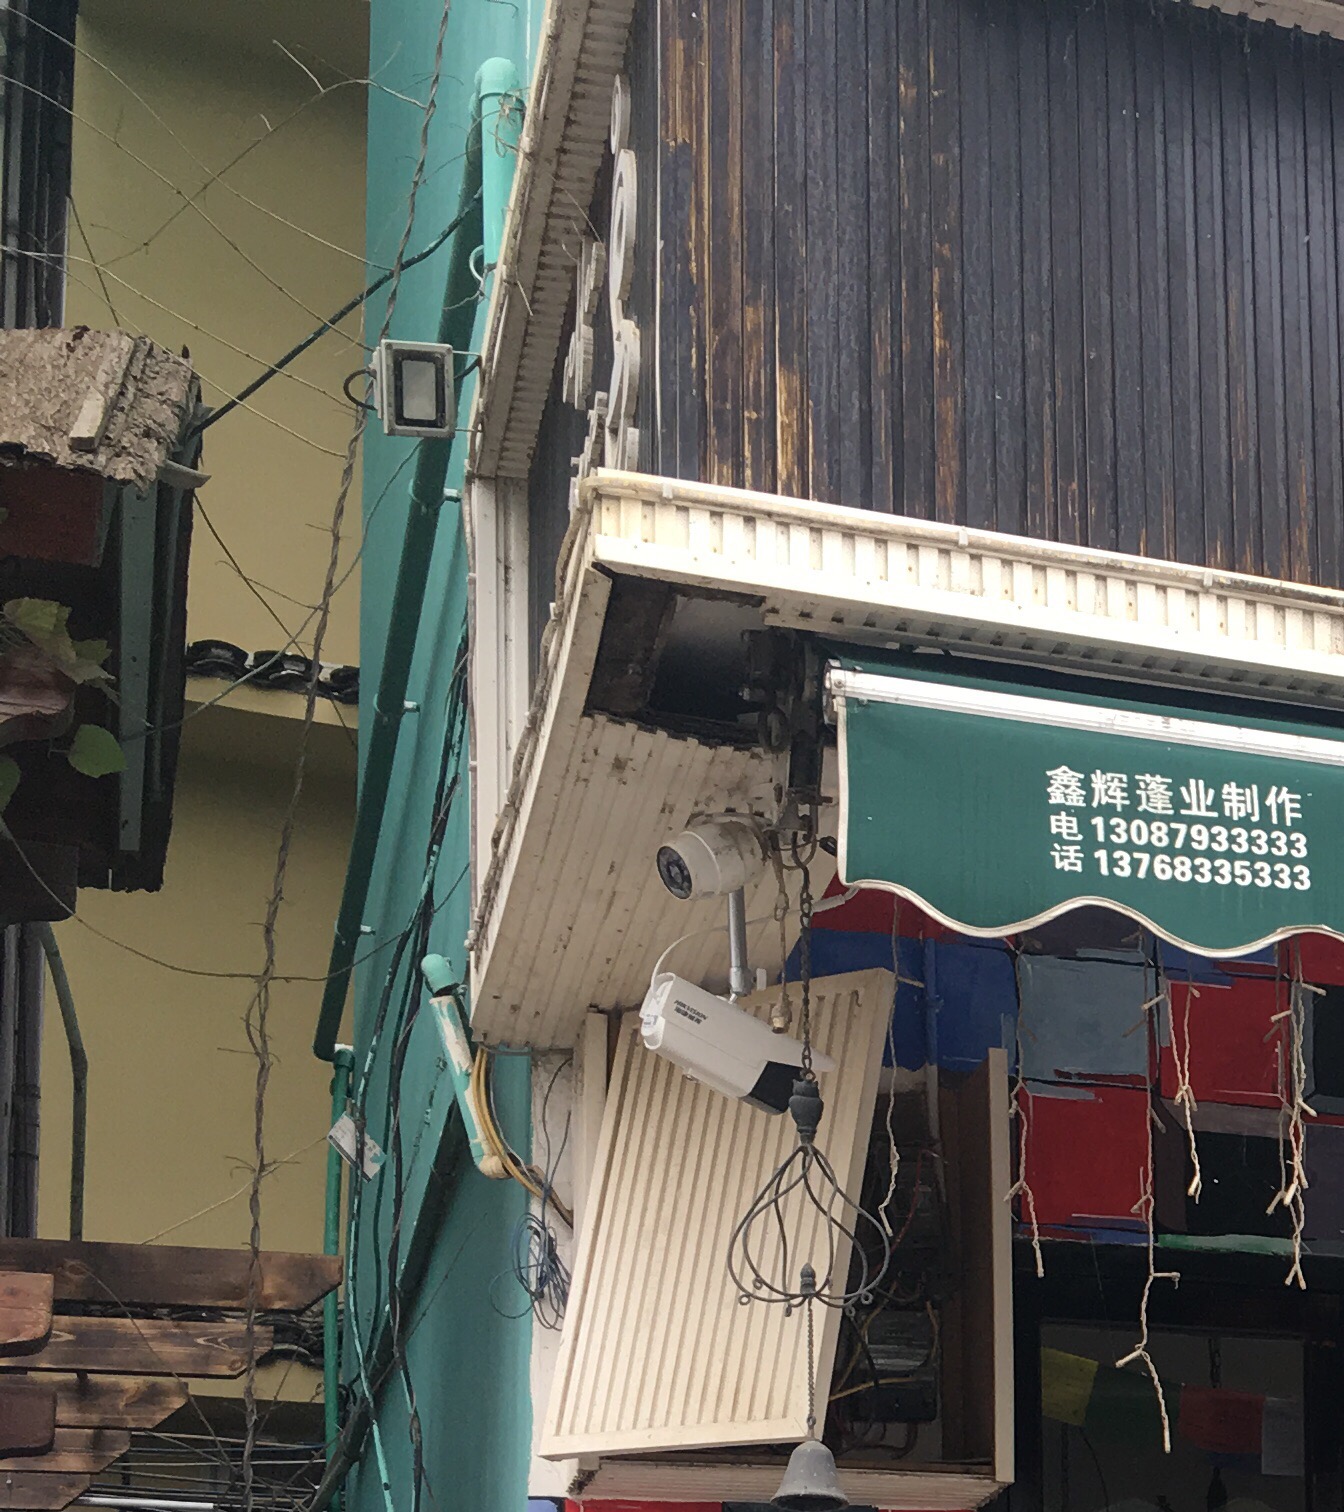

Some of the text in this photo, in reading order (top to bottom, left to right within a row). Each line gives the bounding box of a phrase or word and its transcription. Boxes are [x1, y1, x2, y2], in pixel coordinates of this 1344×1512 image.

[1046, 764, 1303, 827] 鑫辉蓬业制作
[1090, 815, 1308, 858] 13087933333
[1094, 848, 1312, 891] 13768335333
